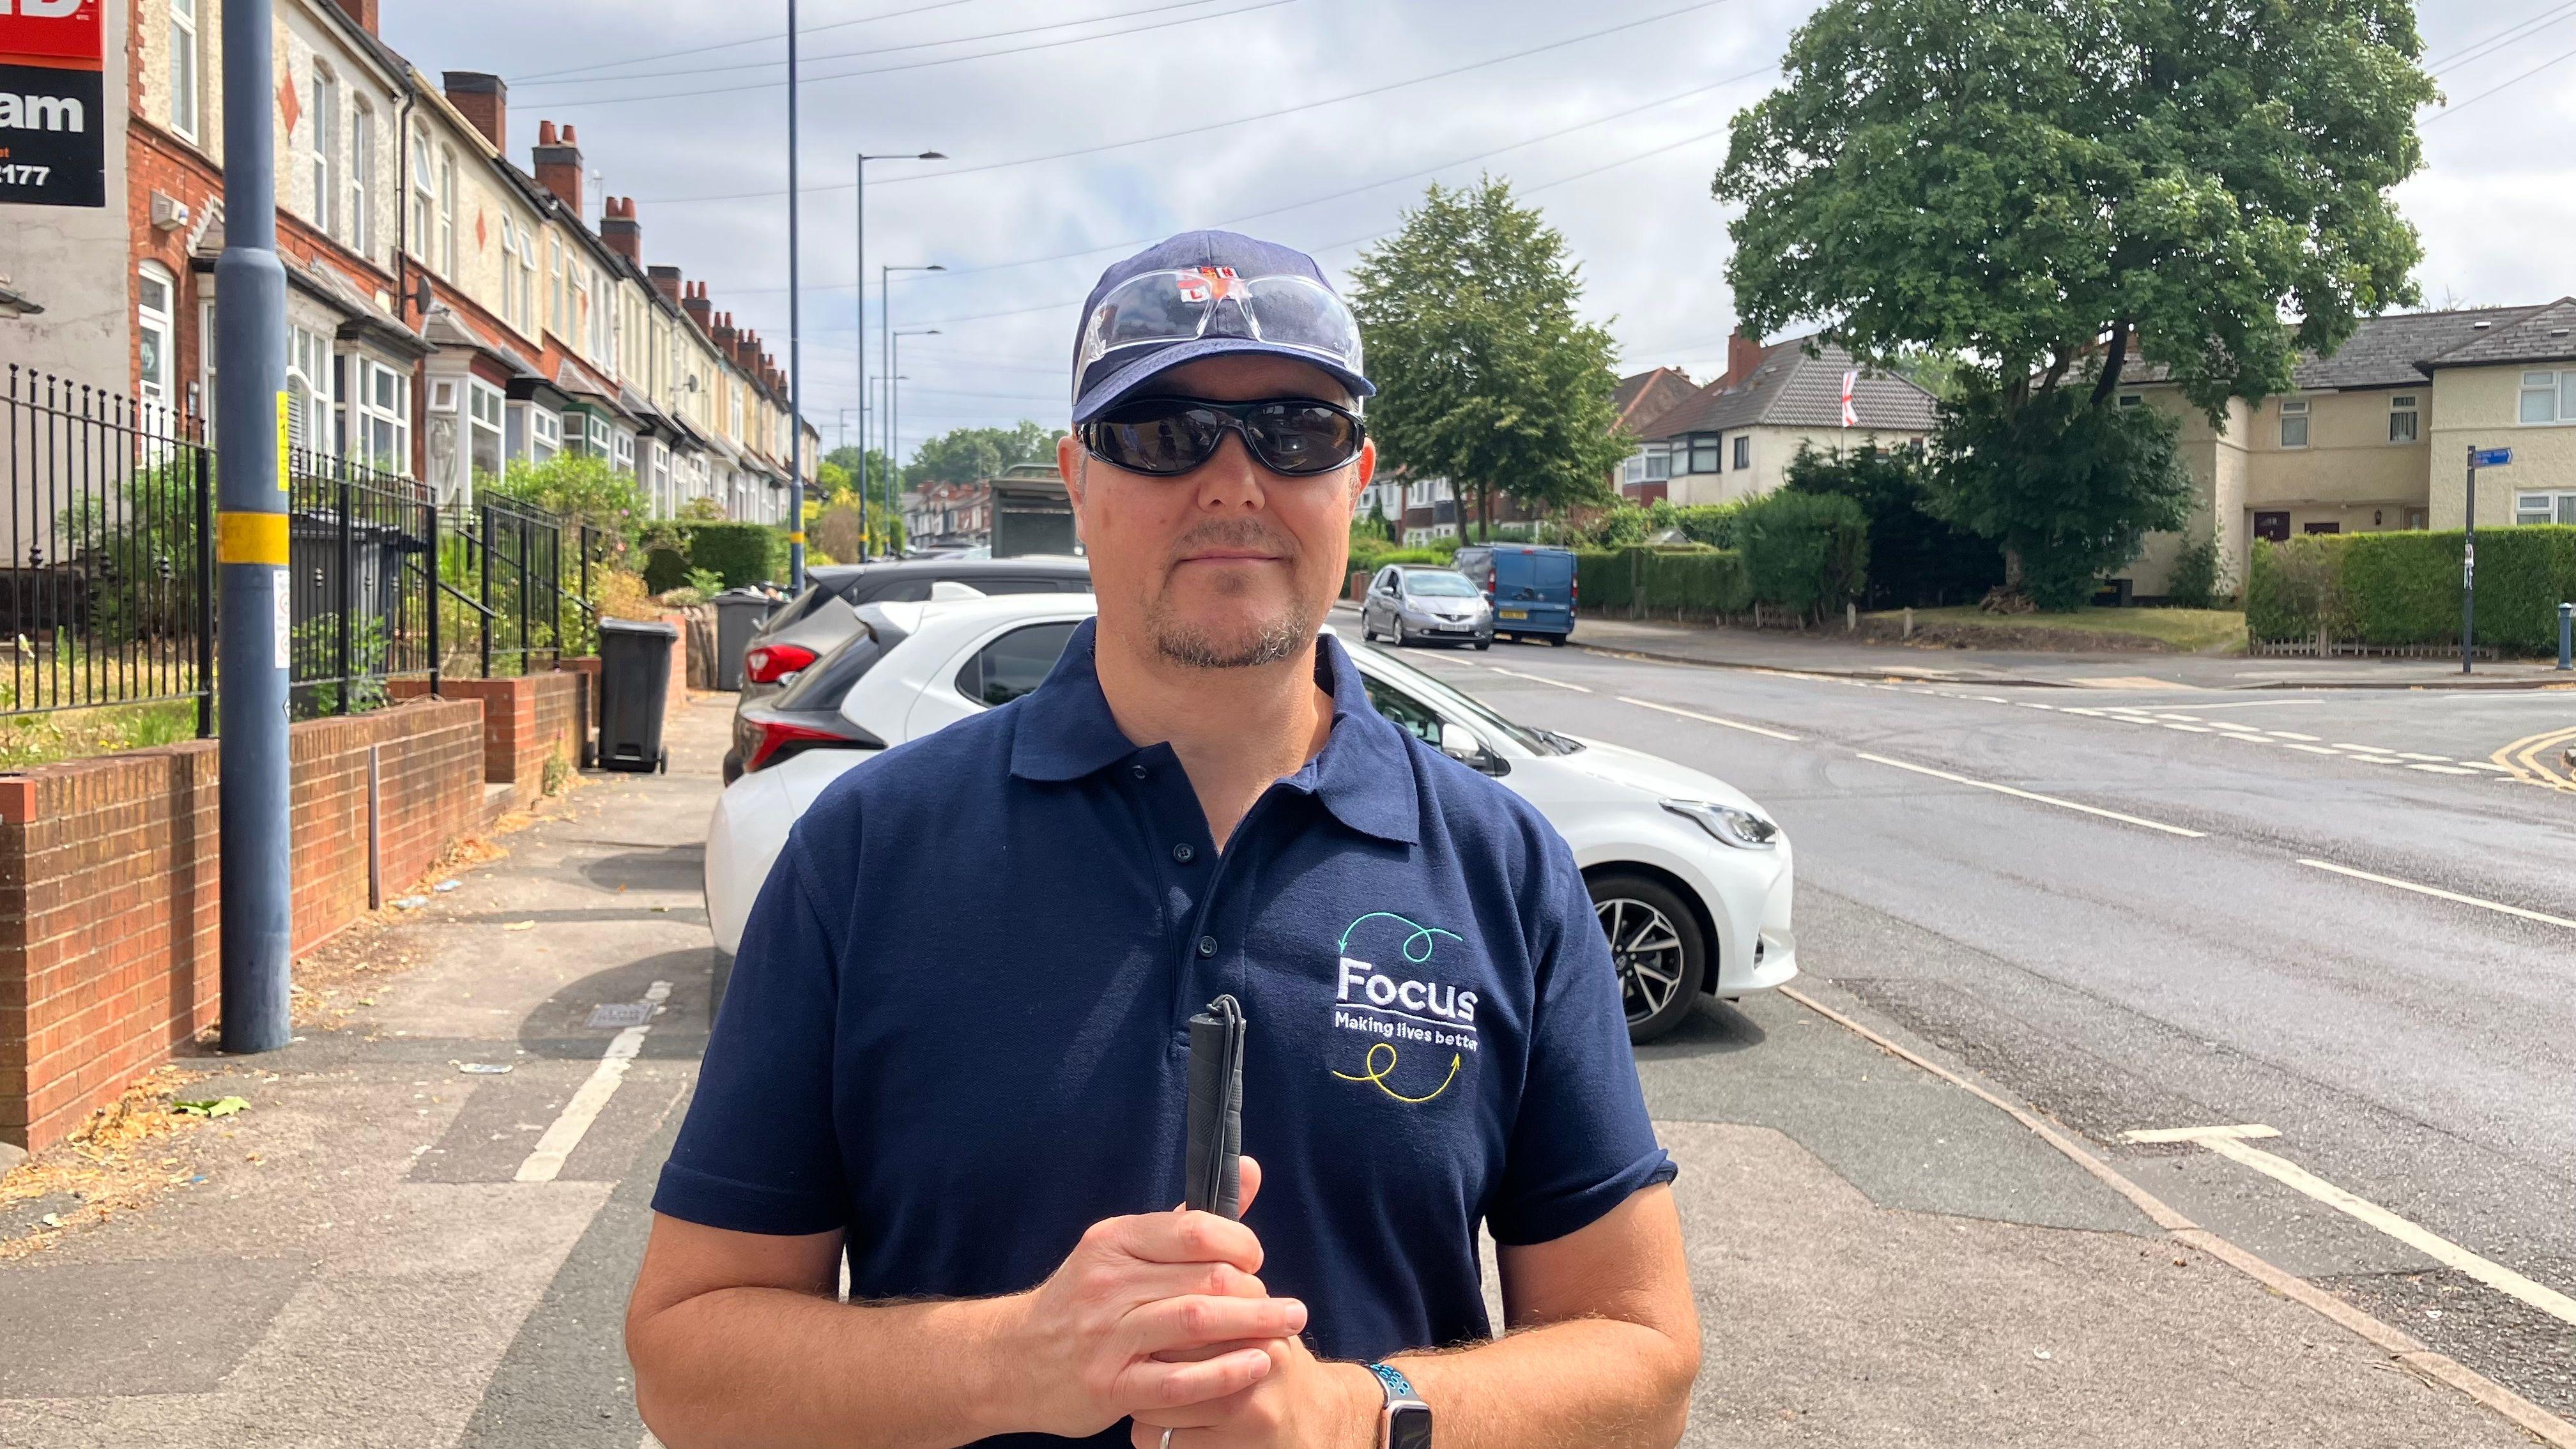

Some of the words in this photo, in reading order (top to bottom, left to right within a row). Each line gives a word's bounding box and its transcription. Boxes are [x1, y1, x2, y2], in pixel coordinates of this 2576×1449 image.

[0, 164, 51, 186] 177
[1336, 957, 1478, 1022] Focus
[1335, 1011, 1393, 1038] Making
[1397, 1022, 1432, 1042] lives
